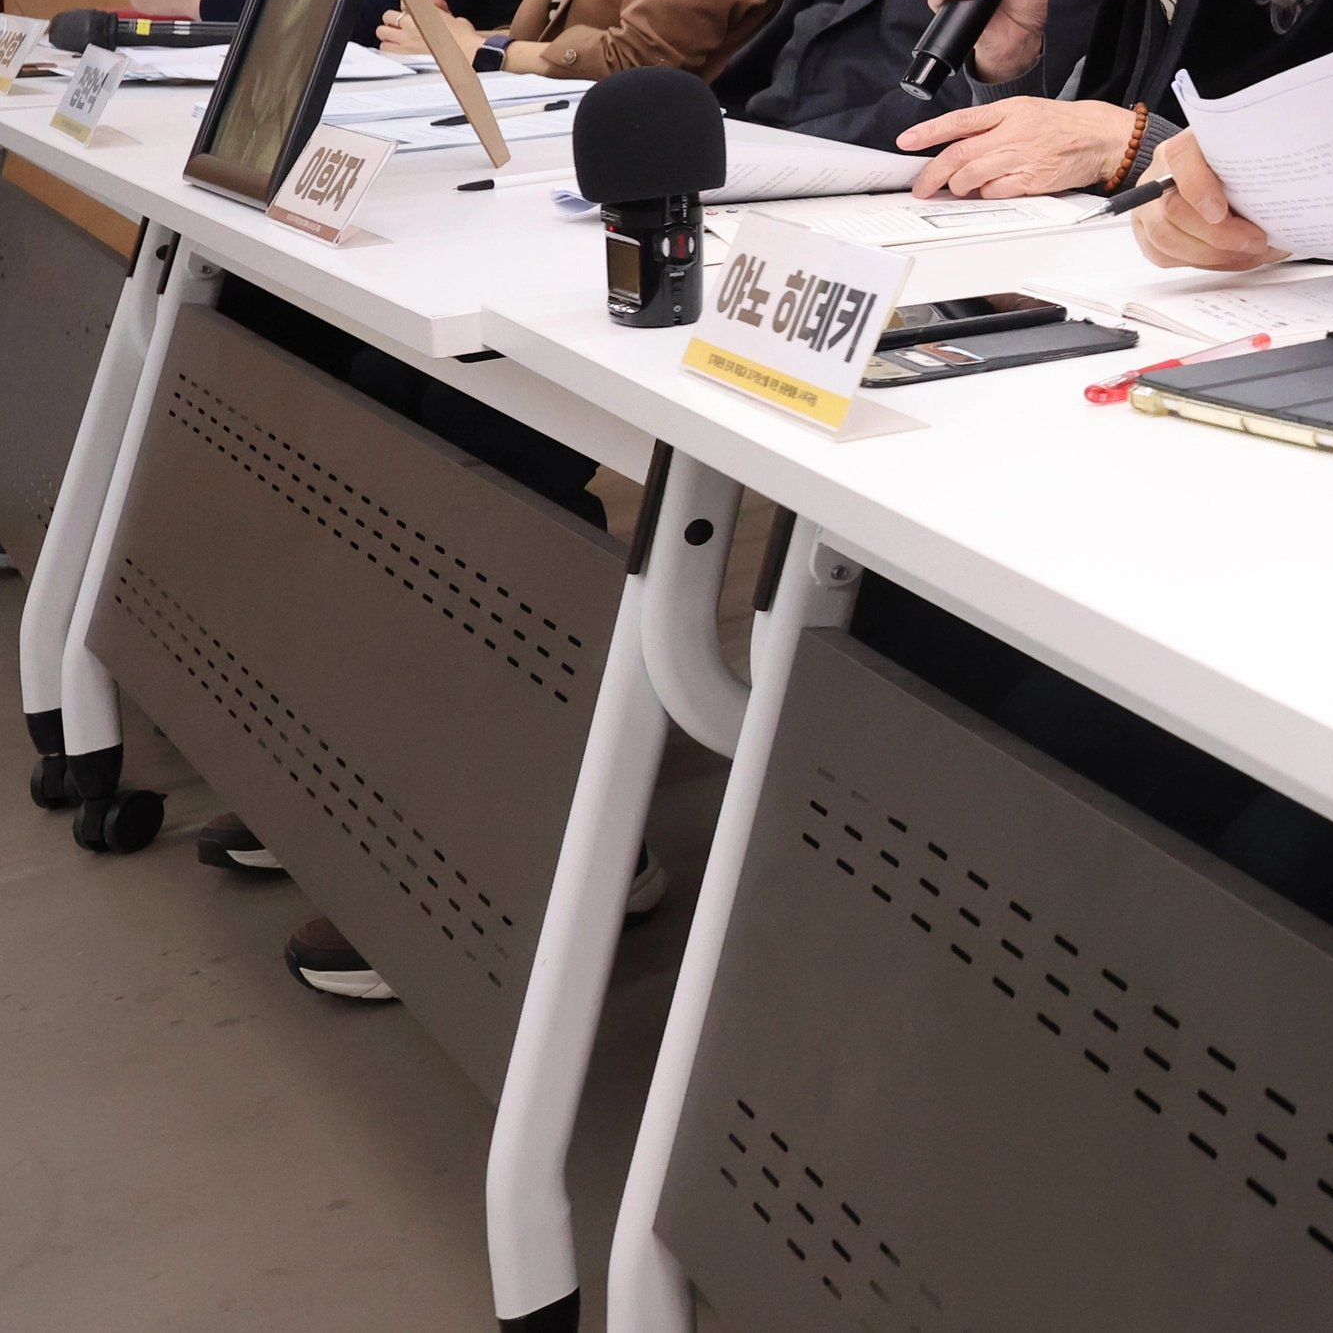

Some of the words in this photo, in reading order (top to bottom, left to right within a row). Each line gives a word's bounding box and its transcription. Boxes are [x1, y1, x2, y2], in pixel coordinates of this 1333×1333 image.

[294, 146, 367, 212] 이희자
[717, 253, 771, 328] 야노
[771, 269, 878, 363] 히데키
